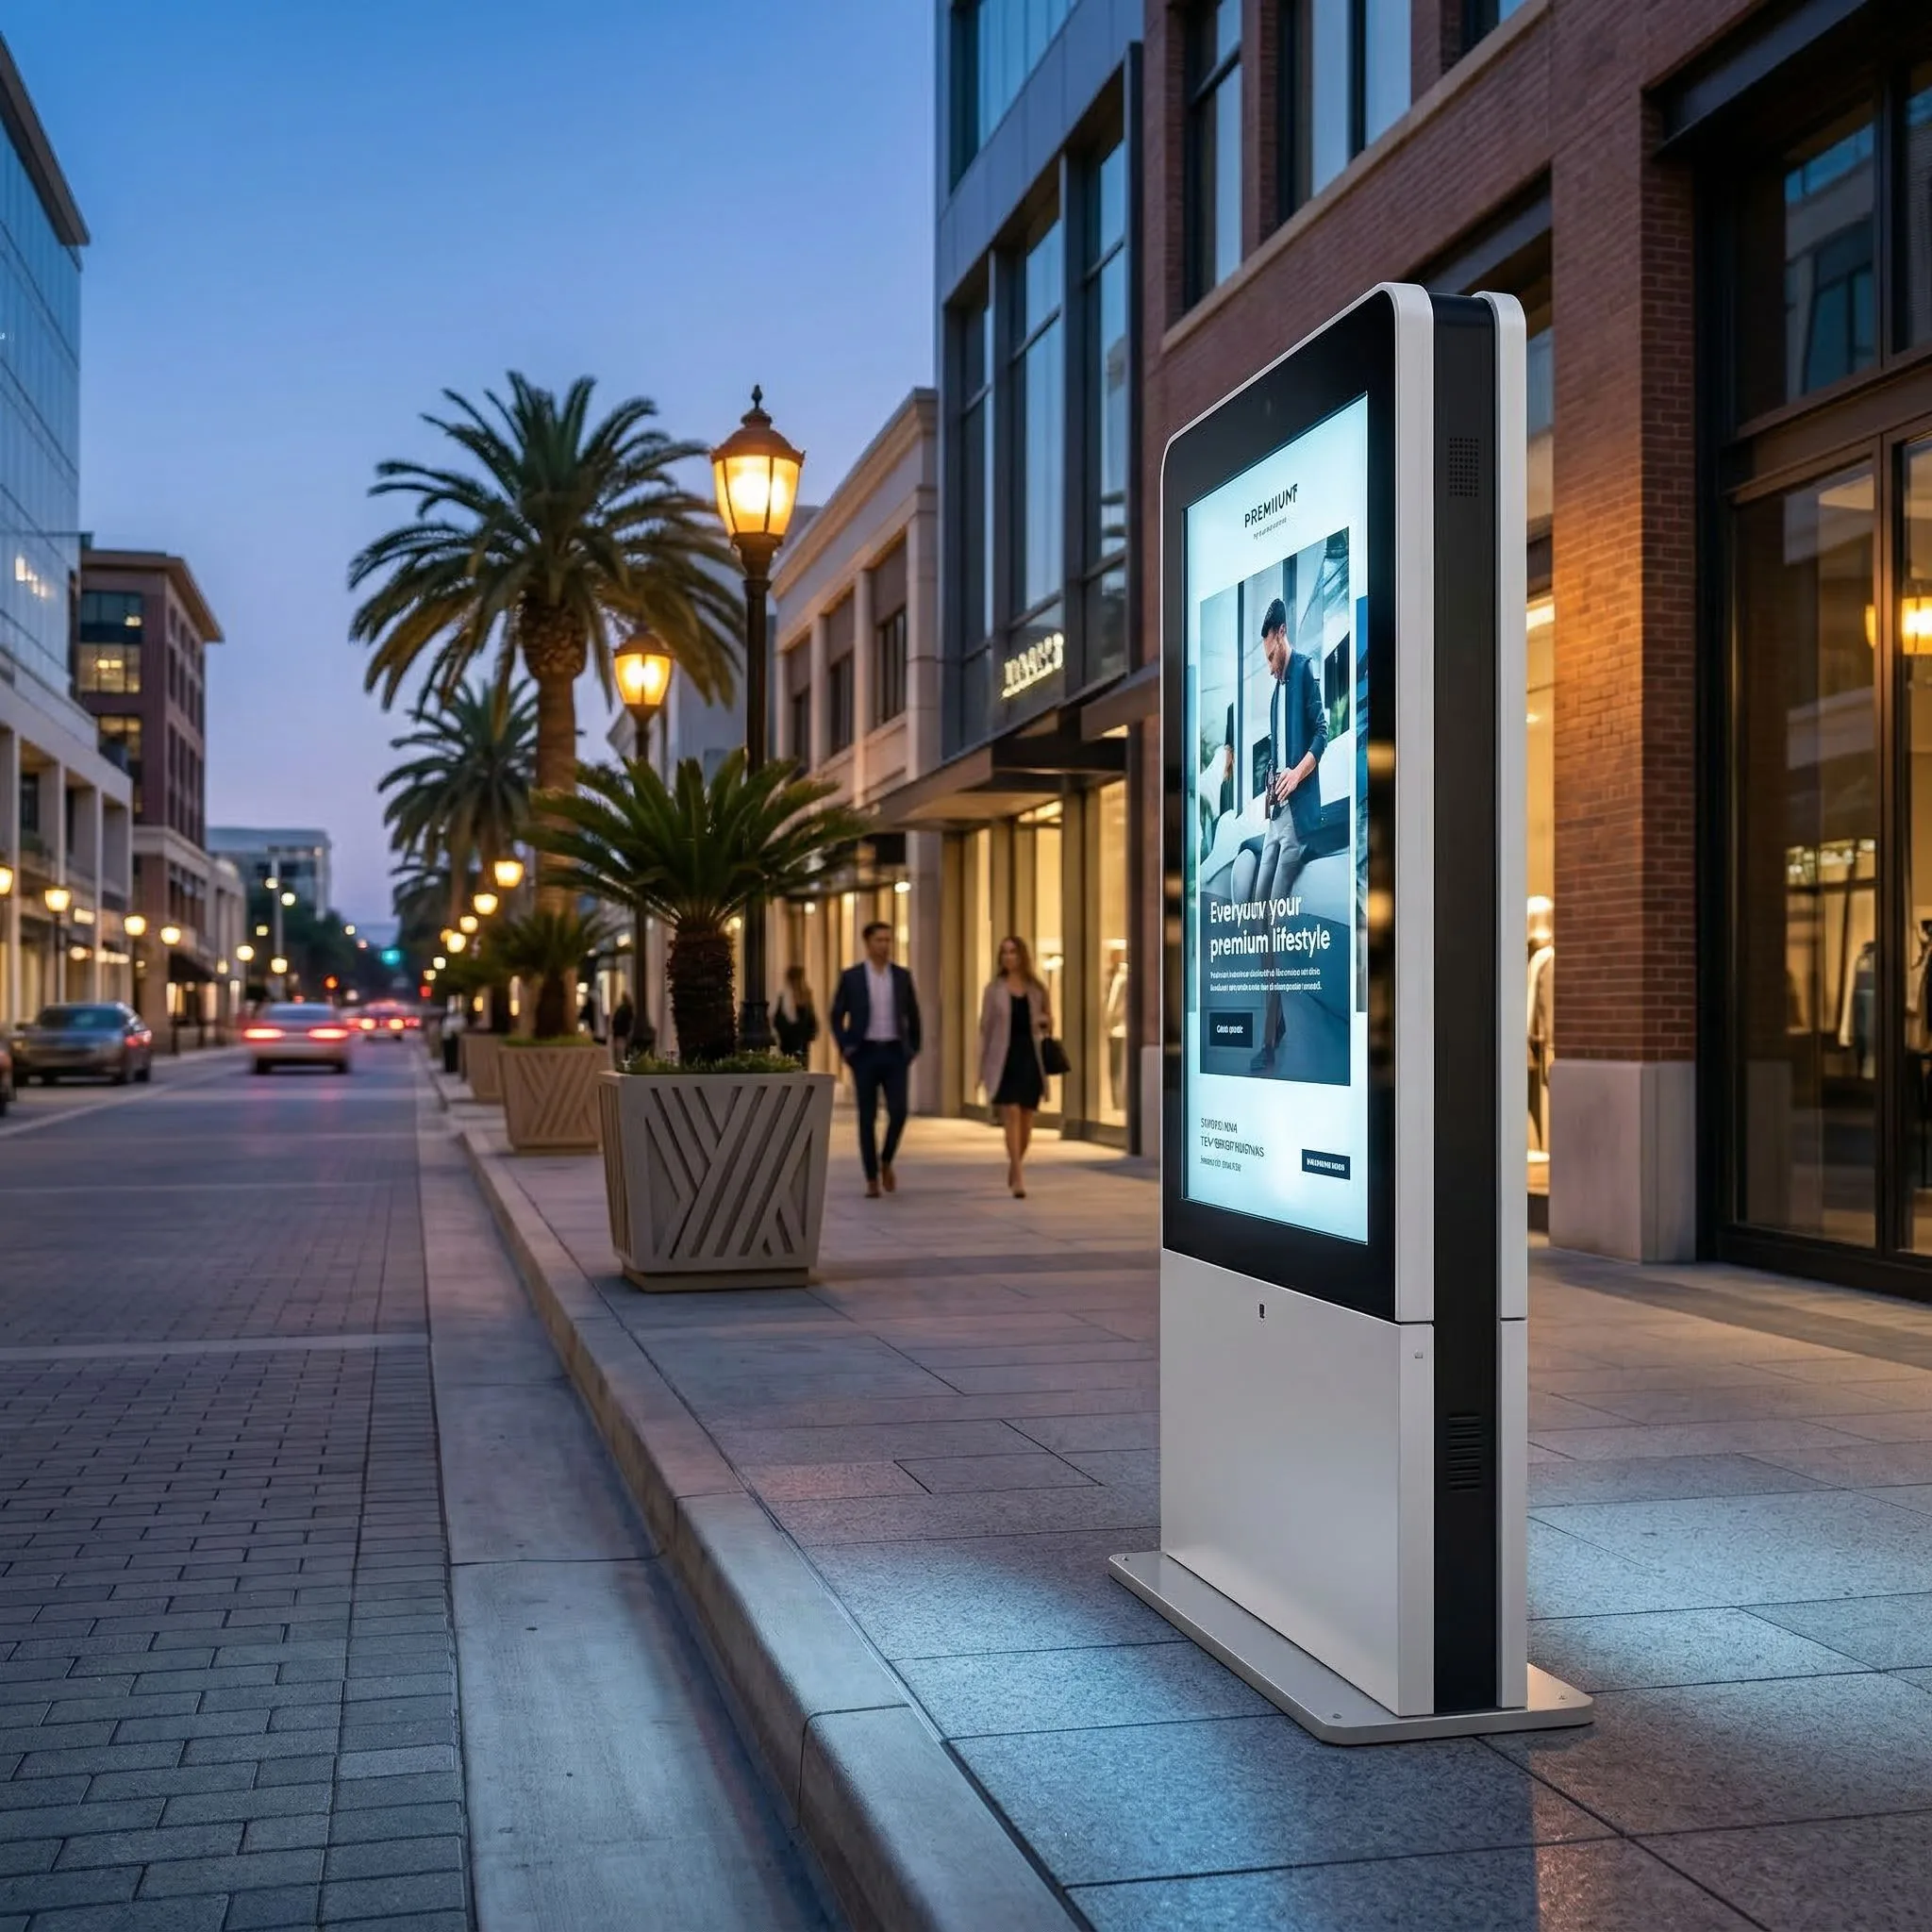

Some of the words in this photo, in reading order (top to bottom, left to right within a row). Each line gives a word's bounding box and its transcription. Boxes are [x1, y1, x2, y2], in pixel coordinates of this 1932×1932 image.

[1269, 896, 1302, 925] your
[1210, 929, 1269, 963] premium
[1273, 924, 1331, 958] lifestyle
